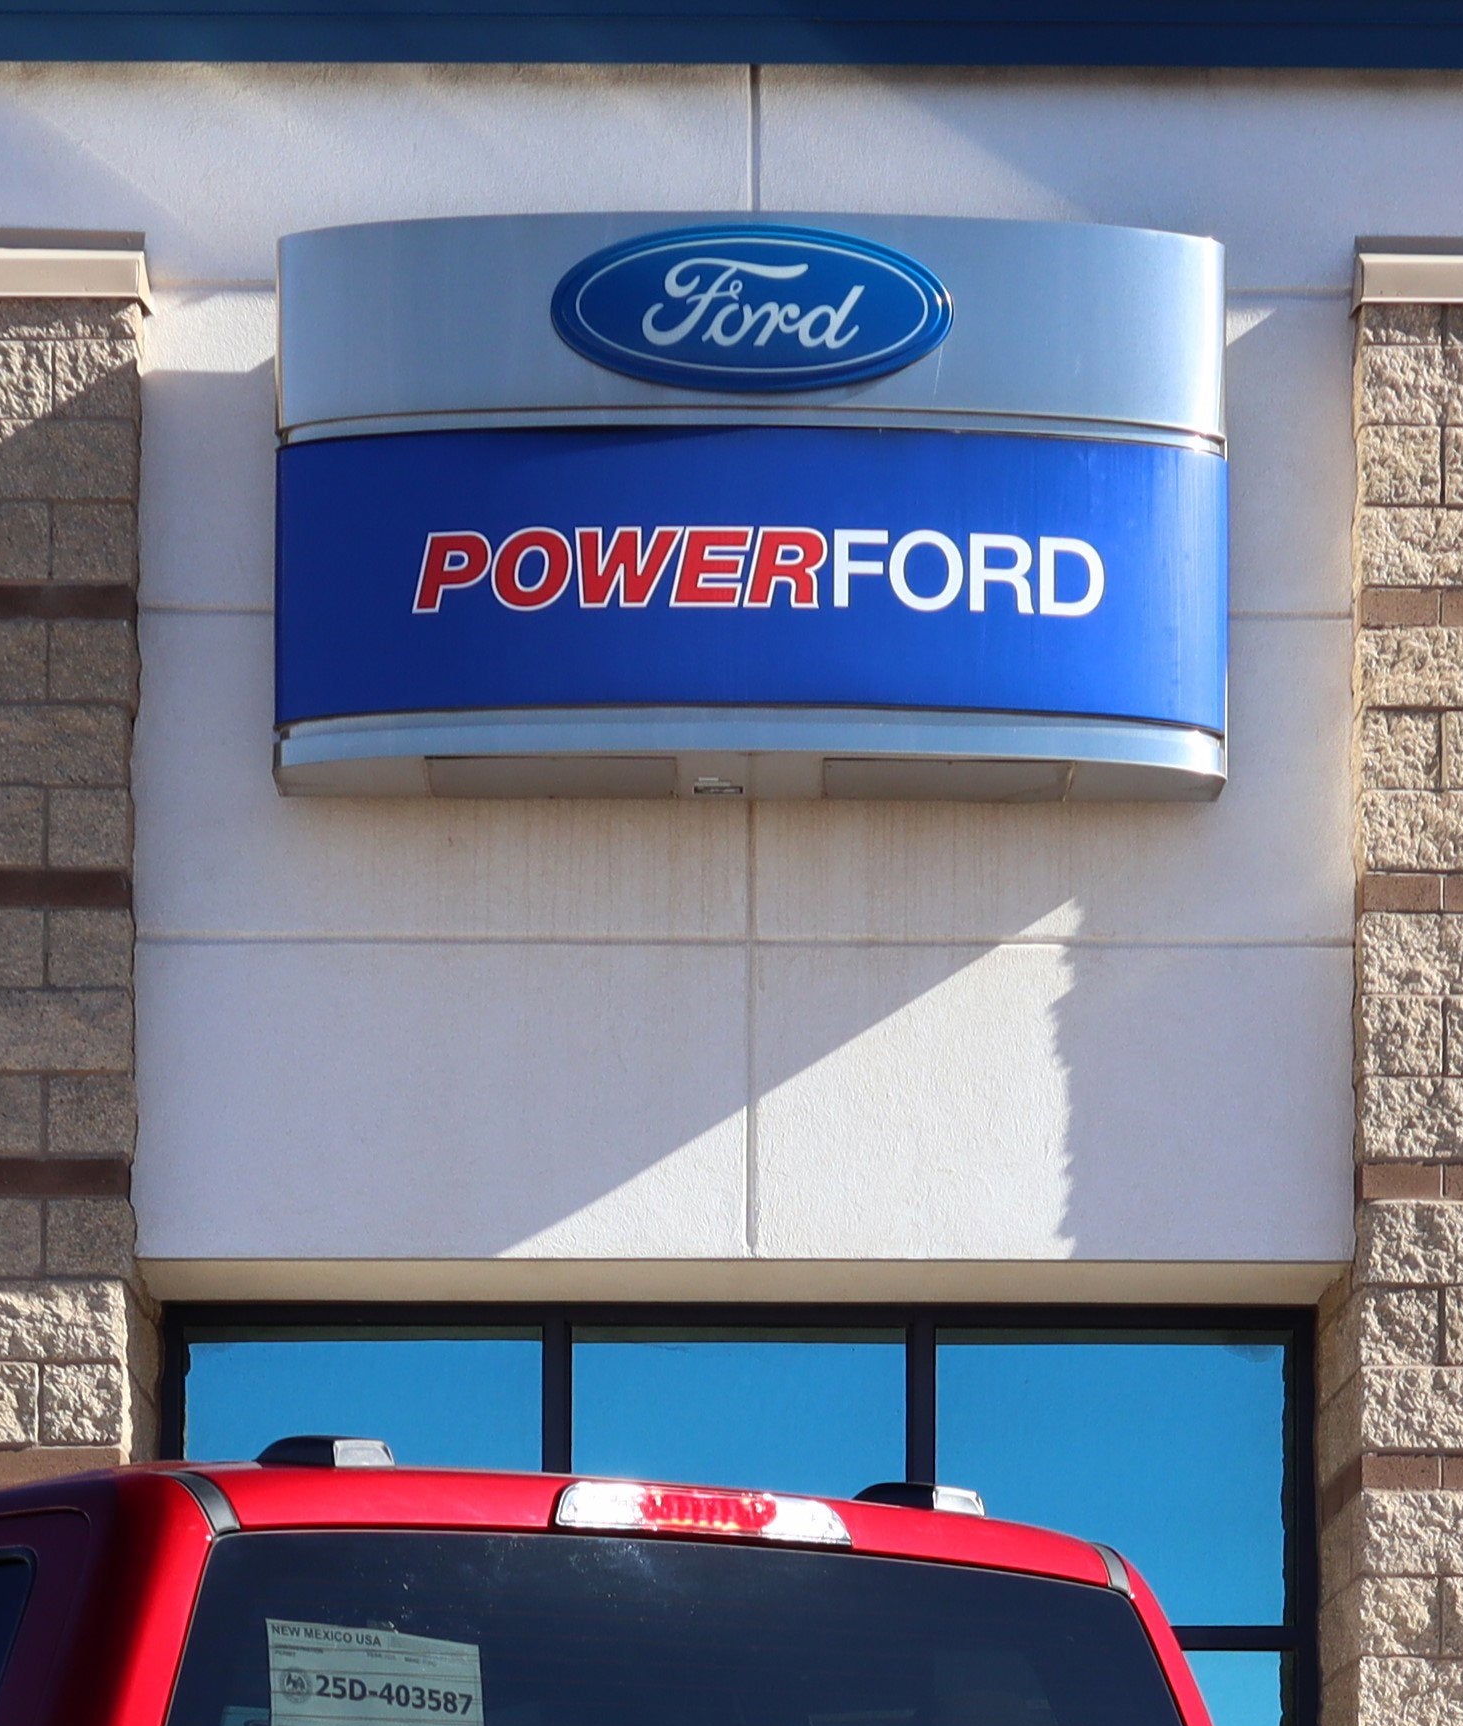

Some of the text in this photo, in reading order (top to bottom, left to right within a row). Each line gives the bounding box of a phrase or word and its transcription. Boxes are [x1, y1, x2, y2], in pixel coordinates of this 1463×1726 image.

[641, 255, 866, 351] Ford
[411, 525, 1106, 619] POWERFORD
[271, 1624, 382, 1648] NEW MEXICO USA
[315, 1674, 473, 1715] 25D-403587
